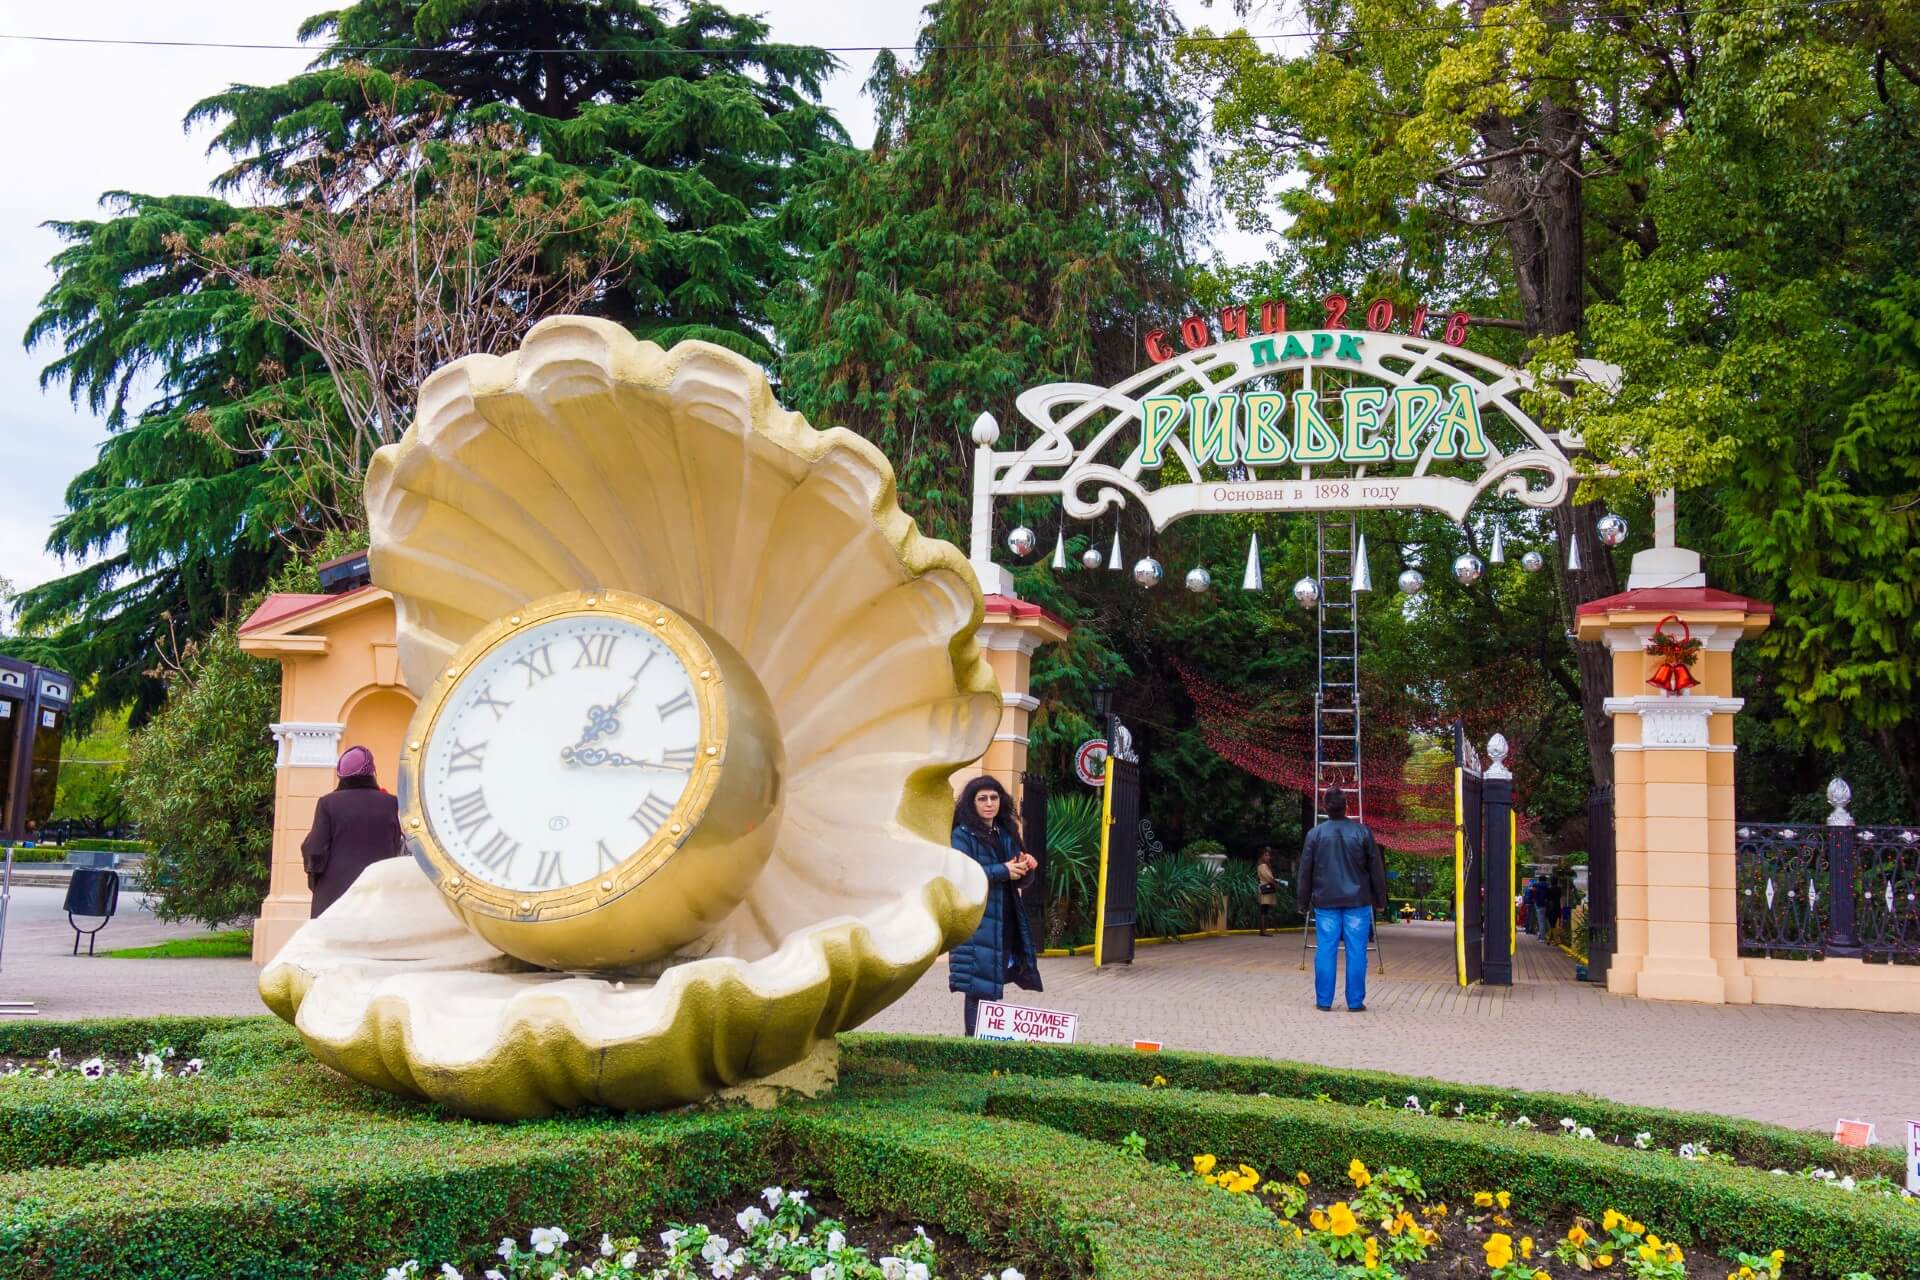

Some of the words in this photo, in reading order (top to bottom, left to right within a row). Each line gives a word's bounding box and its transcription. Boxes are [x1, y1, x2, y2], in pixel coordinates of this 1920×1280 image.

[1323, 294, 1471, 347] 2016
[1250, 333, 1365, 367] ПАРК
[1139, 384, 1489, 469] РИВЬЕРА
[1213, 487, 1283, 502] Основан
[1294, 491, 1303, 500] в
[1315, 484, 1350, 499] 1898
[1361, 486, 1400, 501] году
[512, 642, 555, 688] XI
[572, 634, 621, 670] XII
[471, 685, 514, 720] X
[985, 1005, 1004, 1017] ПО
[1014, 1010, 1070, 1027] КЛУМБЕ
[988, 1018, 1005, 1030] НЕ
[1013, 1021, 1065, 1039] ХОДИТЬ
